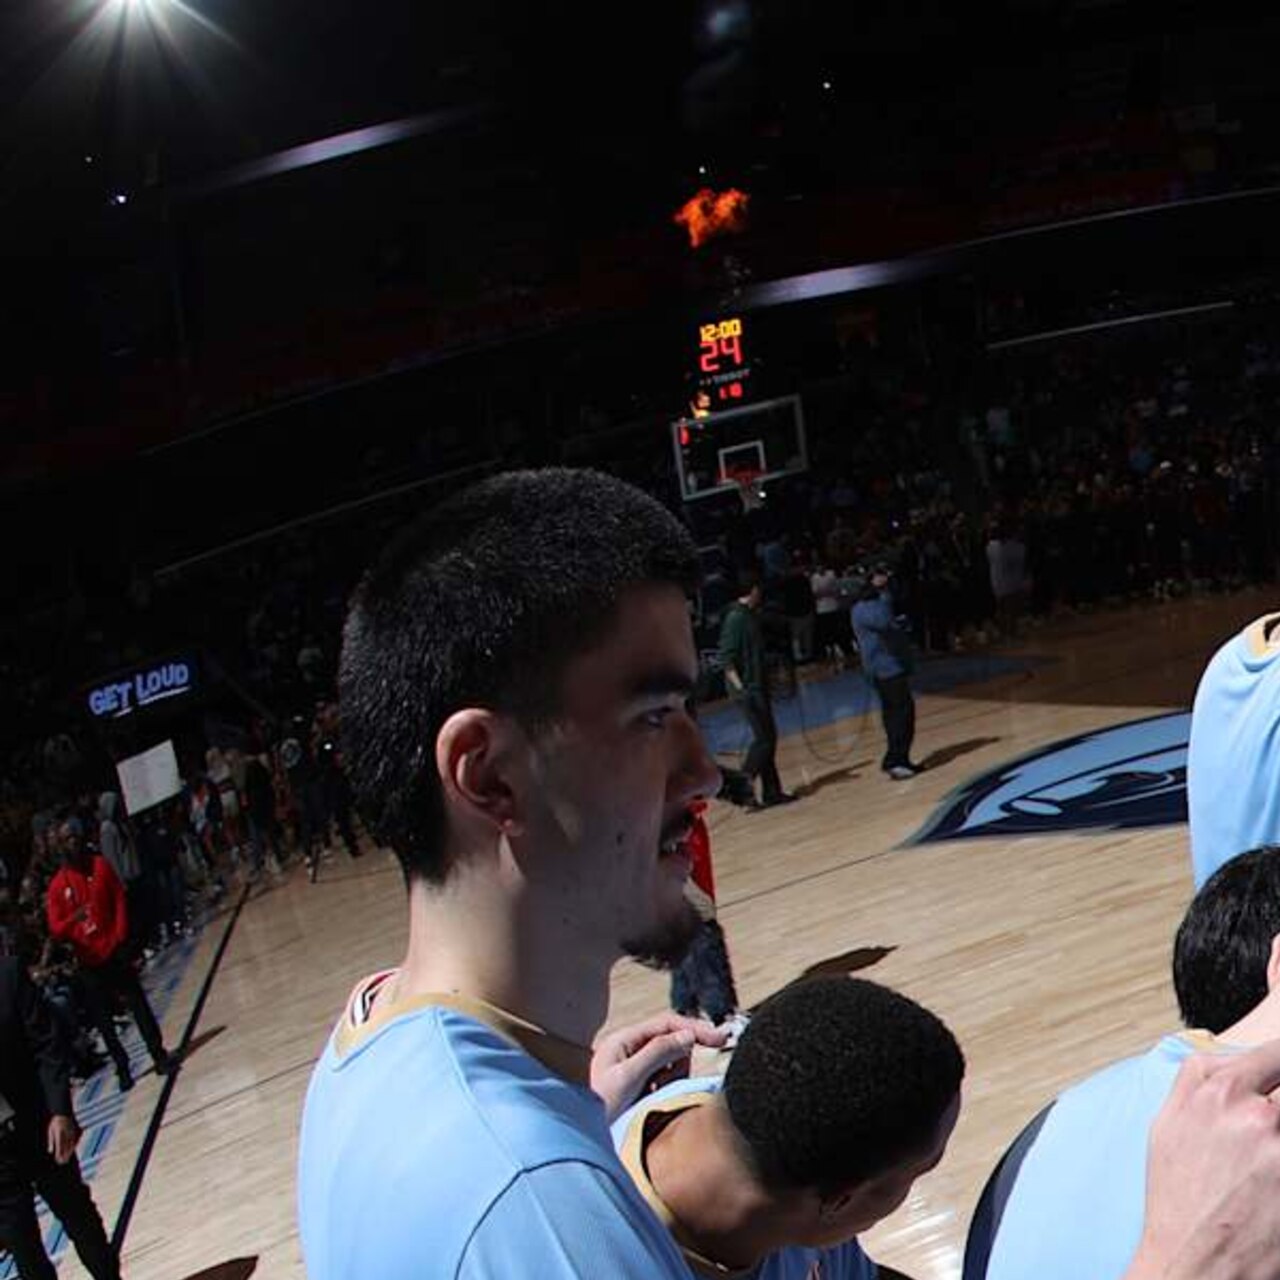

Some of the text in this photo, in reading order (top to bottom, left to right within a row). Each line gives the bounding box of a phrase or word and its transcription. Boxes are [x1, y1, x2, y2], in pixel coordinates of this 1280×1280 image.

[699, 318, 742, 341] 12:00
[699, 338, 742, 371] 24
[89, 663, 189, 715] GET LOUD
